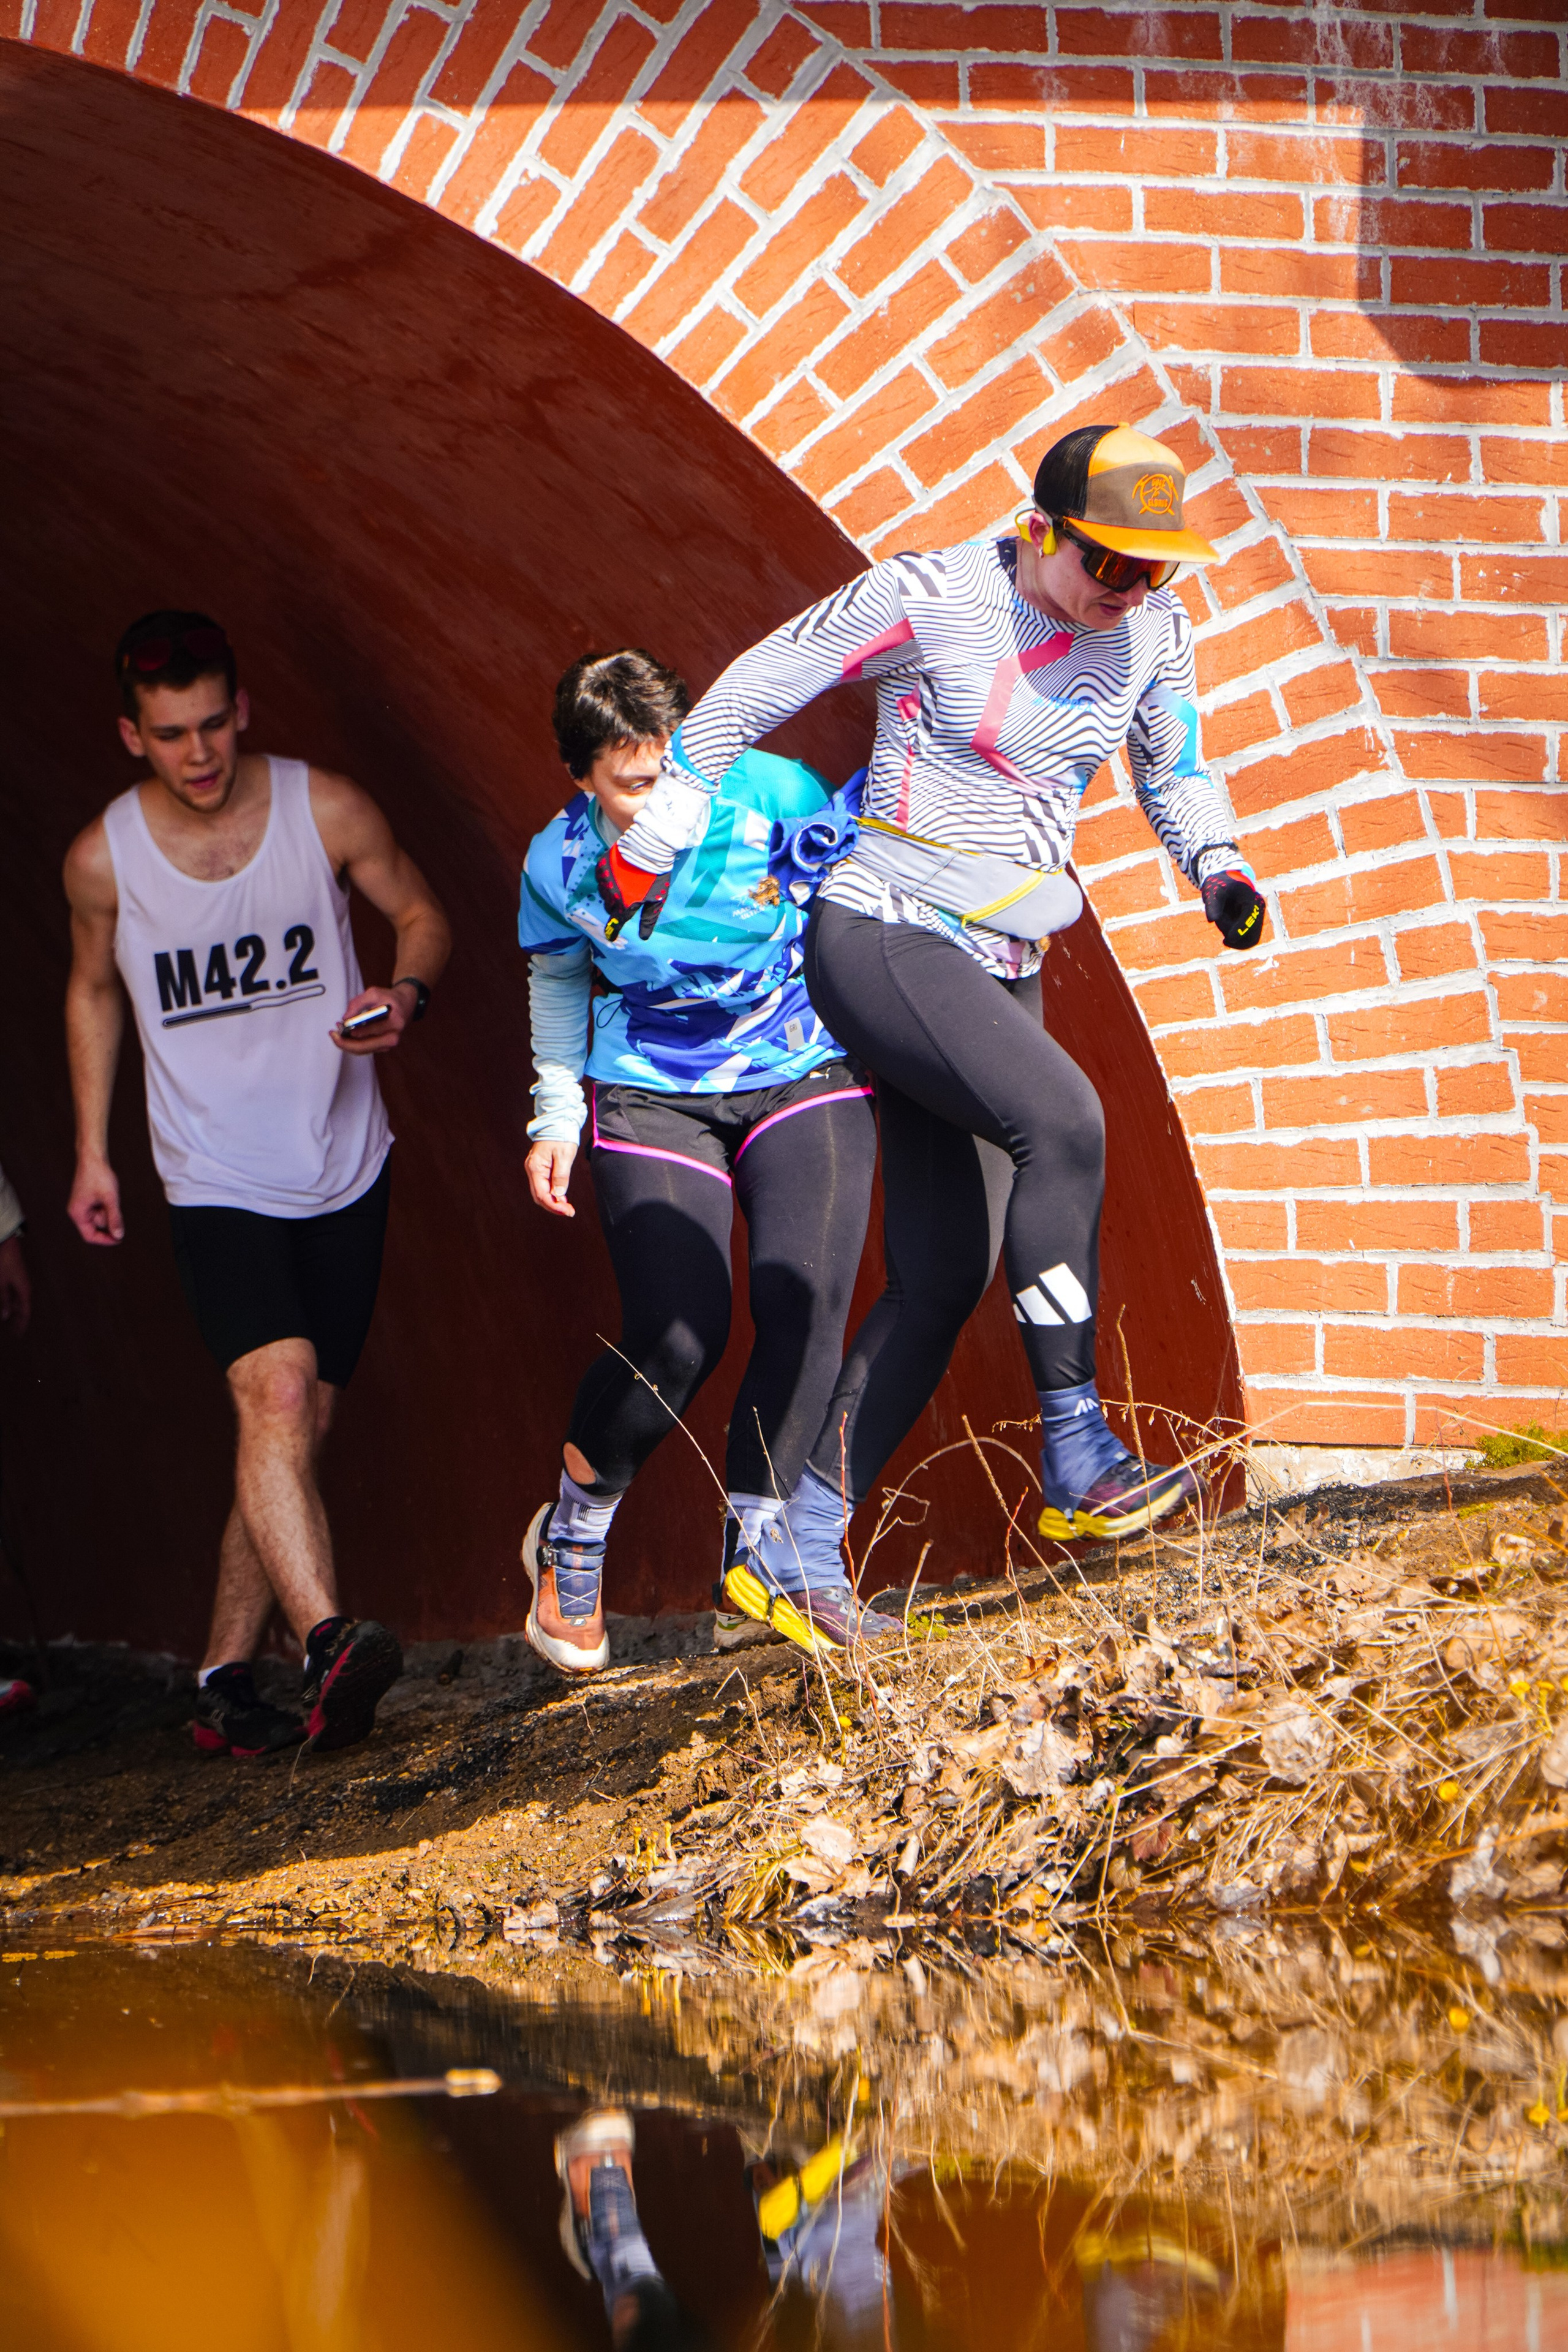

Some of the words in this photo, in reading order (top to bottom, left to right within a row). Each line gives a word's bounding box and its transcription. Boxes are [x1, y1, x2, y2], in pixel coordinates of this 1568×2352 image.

[1049, 696, 1096, 712] TERREX
[1237, 904, 1260, 936] LEKI
[154, 923, 319, 1012] M42.2
